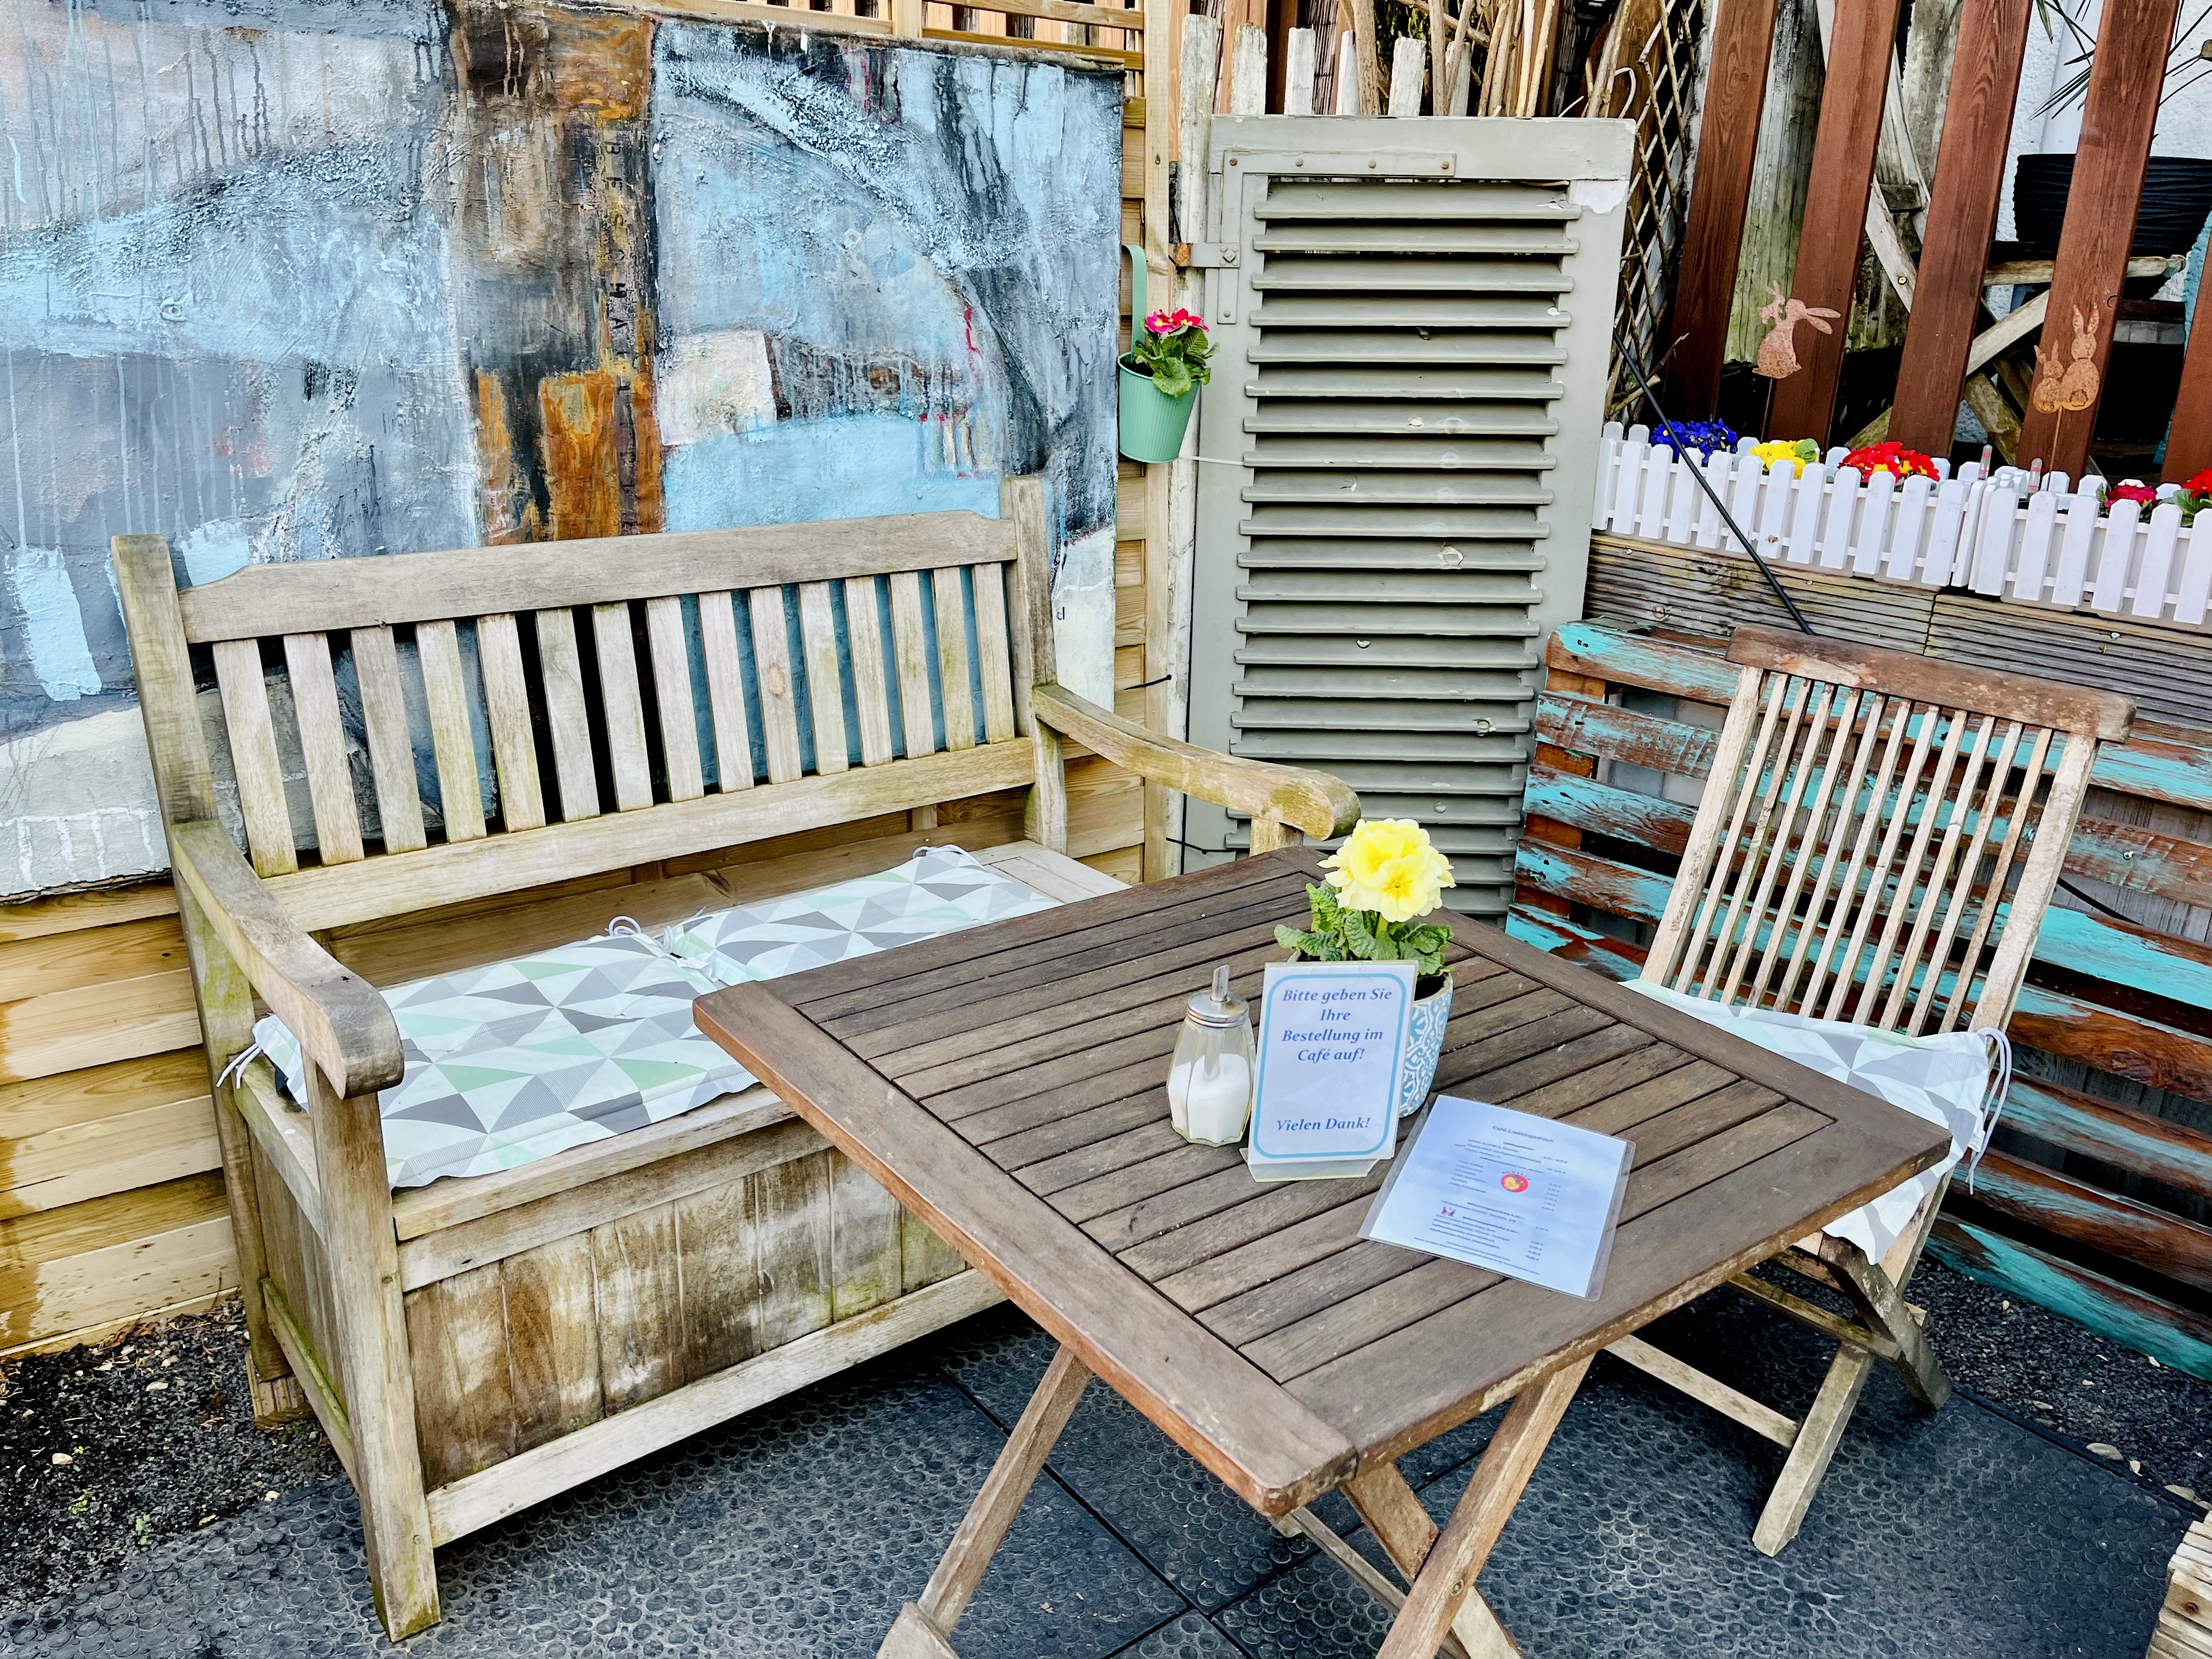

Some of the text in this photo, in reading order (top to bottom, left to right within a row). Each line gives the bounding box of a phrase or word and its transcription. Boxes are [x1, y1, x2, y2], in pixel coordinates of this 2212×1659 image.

[1282, 988, 1392, 1004] Bitte geben Sie
[1320, 1009, 1351, 1021] Ihre
[1282, 1029, 1383, 1043] Bestellung im
[1297, 1048, 1365, 1063] Café auf!
[1277, 1117, 1370, 1131] Vielen Dank!
